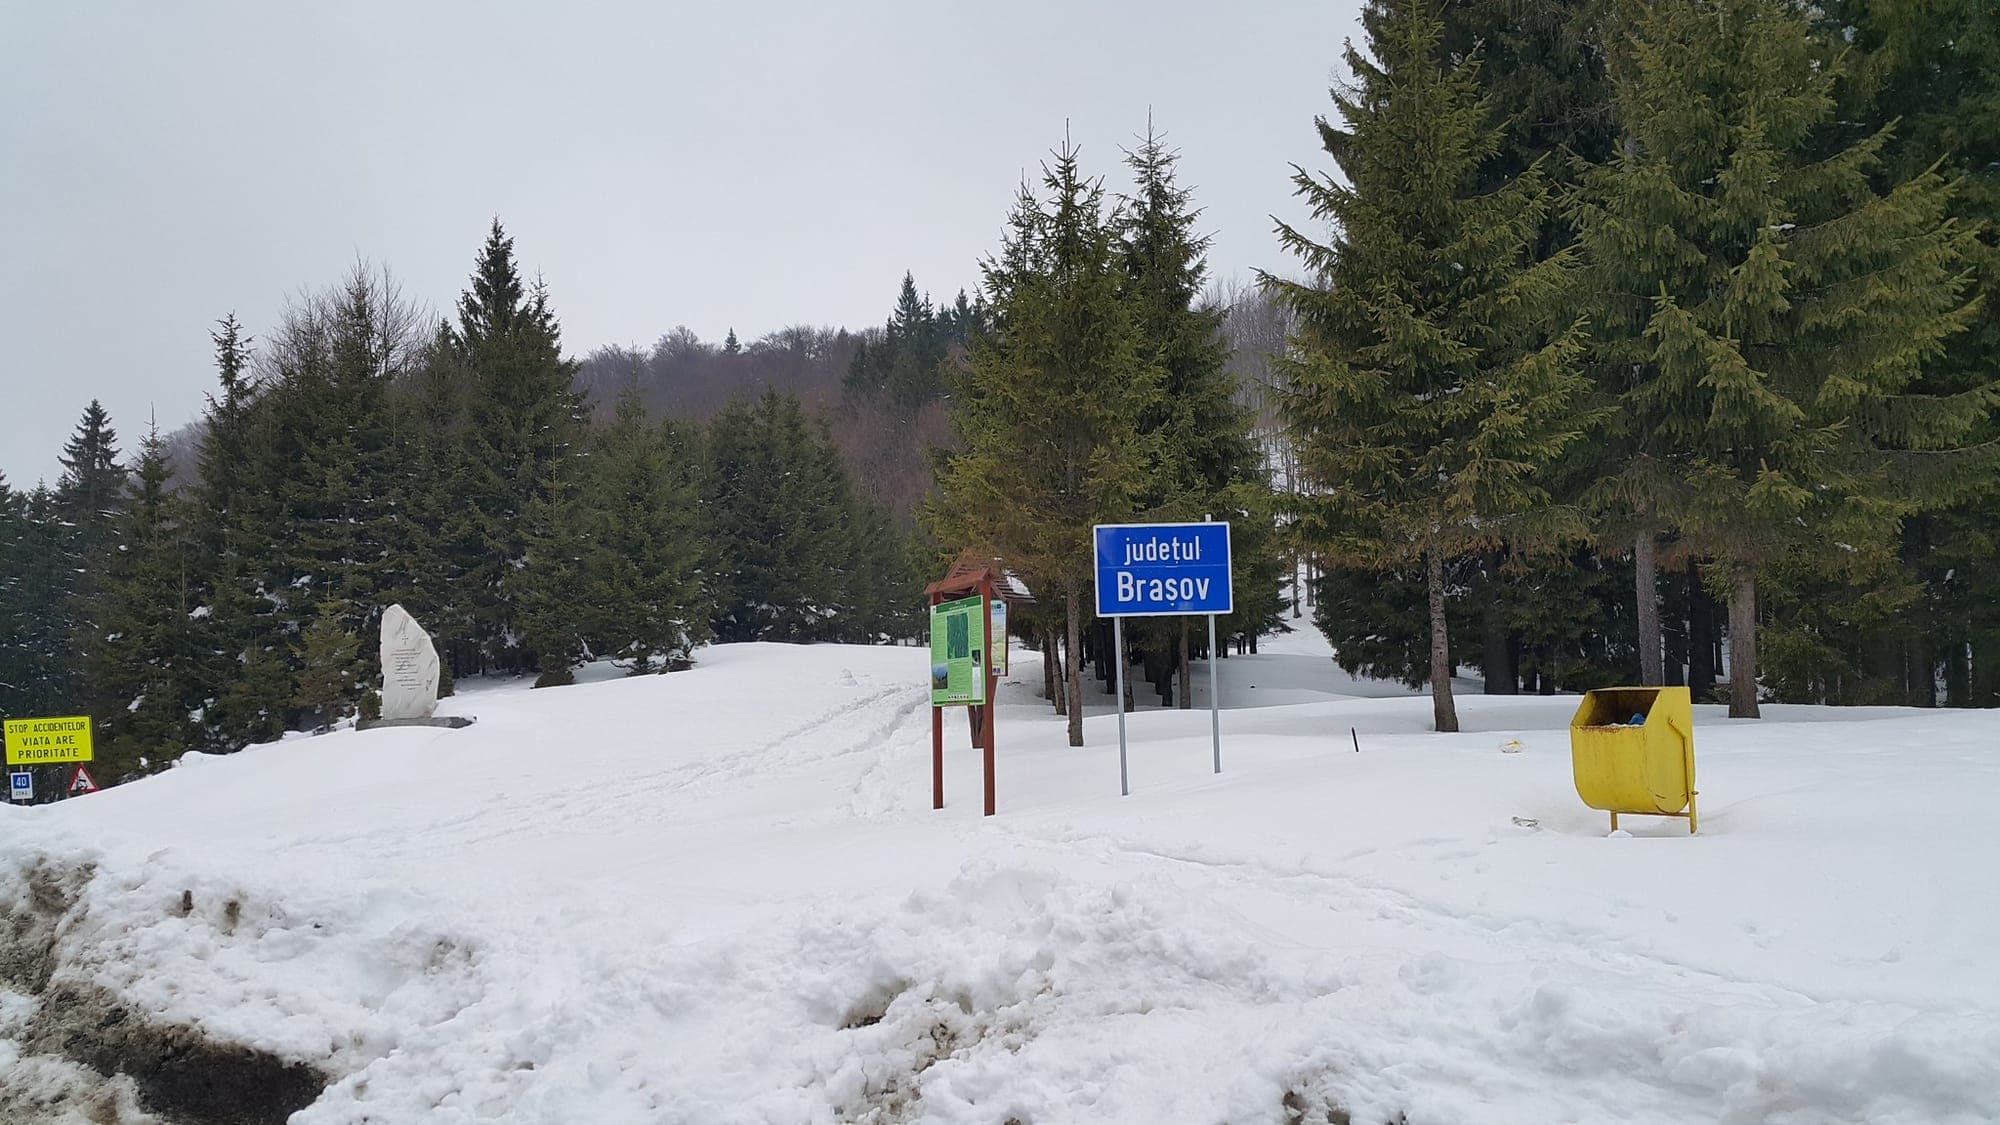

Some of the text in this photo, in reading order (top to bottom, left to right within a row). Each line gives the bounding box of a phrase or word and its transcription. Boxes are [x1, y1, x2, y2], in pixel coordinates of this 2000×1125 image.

[1124, 535, 1200, 565] județul
[1117, 571, 1210, 606] Brașov
[9, 722, 85, 733] STOP ACCIDENTELOR
[22, 735, 75, 746] VIATA ARE
[18, 748, 79, 759] PRIORITATE
[16, 776, 27, 787] 40
